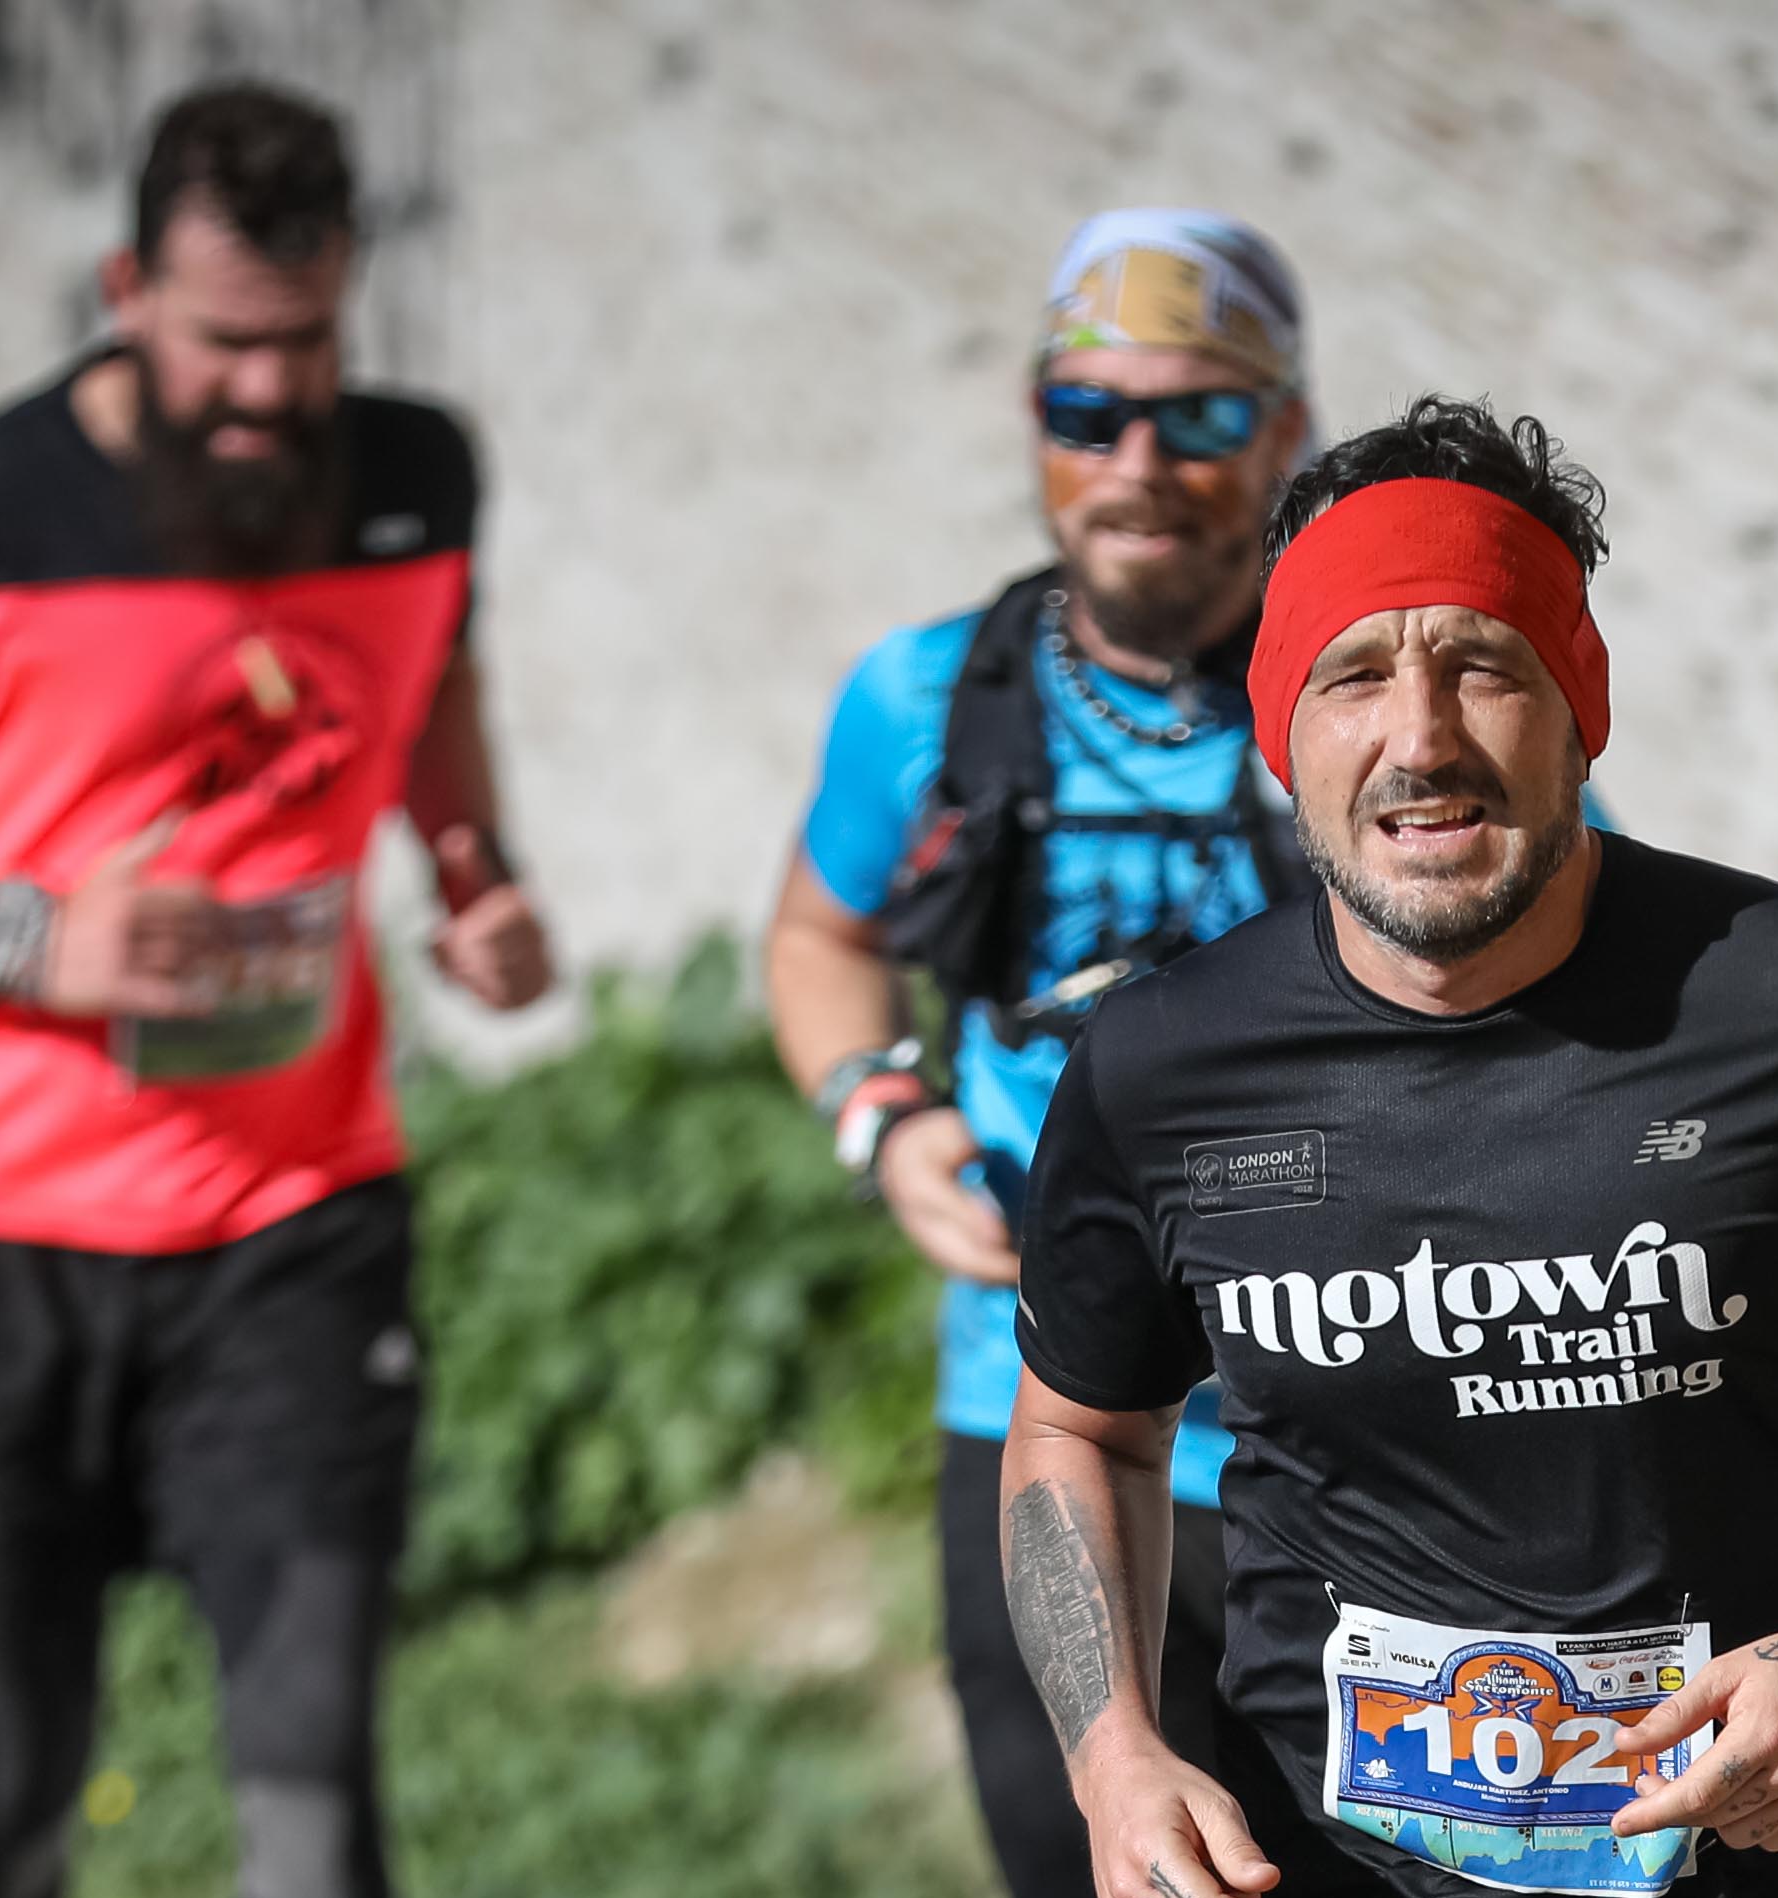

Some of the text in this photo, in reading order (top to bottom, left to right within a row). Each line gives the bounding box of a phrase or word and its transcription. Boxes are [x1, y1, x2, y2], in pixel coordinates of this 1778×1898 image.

[1228, 1150, 1293, 1169] LONDON
[1228, 1164, 1315, 1185] MARATHON
[1216, 1220, 1748, 1367] motown
[1508, 1312, 1657, 1366] Trail
[1451, 1358, 1723, 1419] Running
[1340, 1658, 1381, 1669] SEAT
[1390, 1652, 1436, 1670] VIGILSA
[1474, 1672, 1538, 1686] Alhambra
[1403, 1704, 1629, 1788] 102
